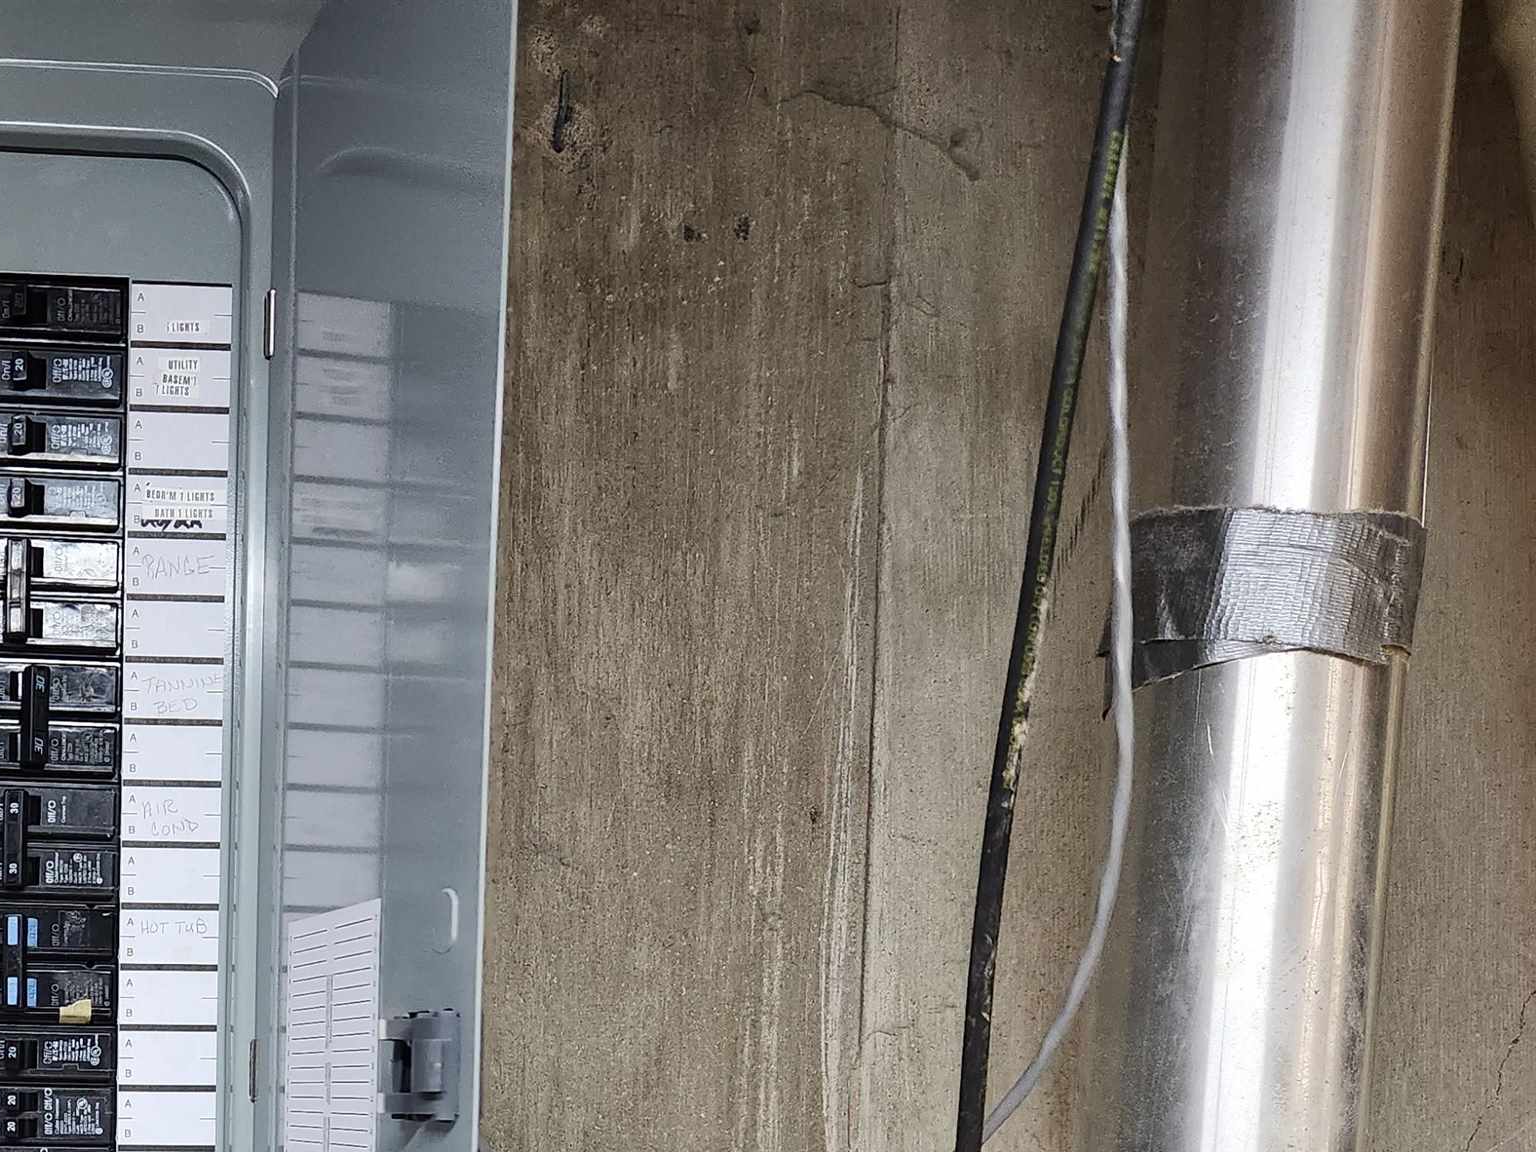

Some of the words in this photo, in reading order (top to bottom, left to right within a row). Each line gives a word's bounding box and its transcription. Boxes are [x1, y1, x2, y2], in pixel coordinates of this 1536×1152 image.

[172, 322, 200, 332] LIGHTS
[16, 358, 24, 371] 20
[168, 359, 197, 370] UTILITY
[161, 386, 189, 396] LIGHTS
[15, 423, 23, 436] 20
[187, 492, 215, 502] LIGHTS
[185, 509, 213, 518] LIGHTS
[35, 675, 45, 692] 30
[154, 698, 198, 714] BED
[34, 738, 44, 754] 30
[10, 803, 19, 814] 30
[142, 799, 178, 819] AIR
[9, 863, 18, 874] 30
[140, 919, 168, 934] HOT
[8, 1047, 17, 1058] 20
